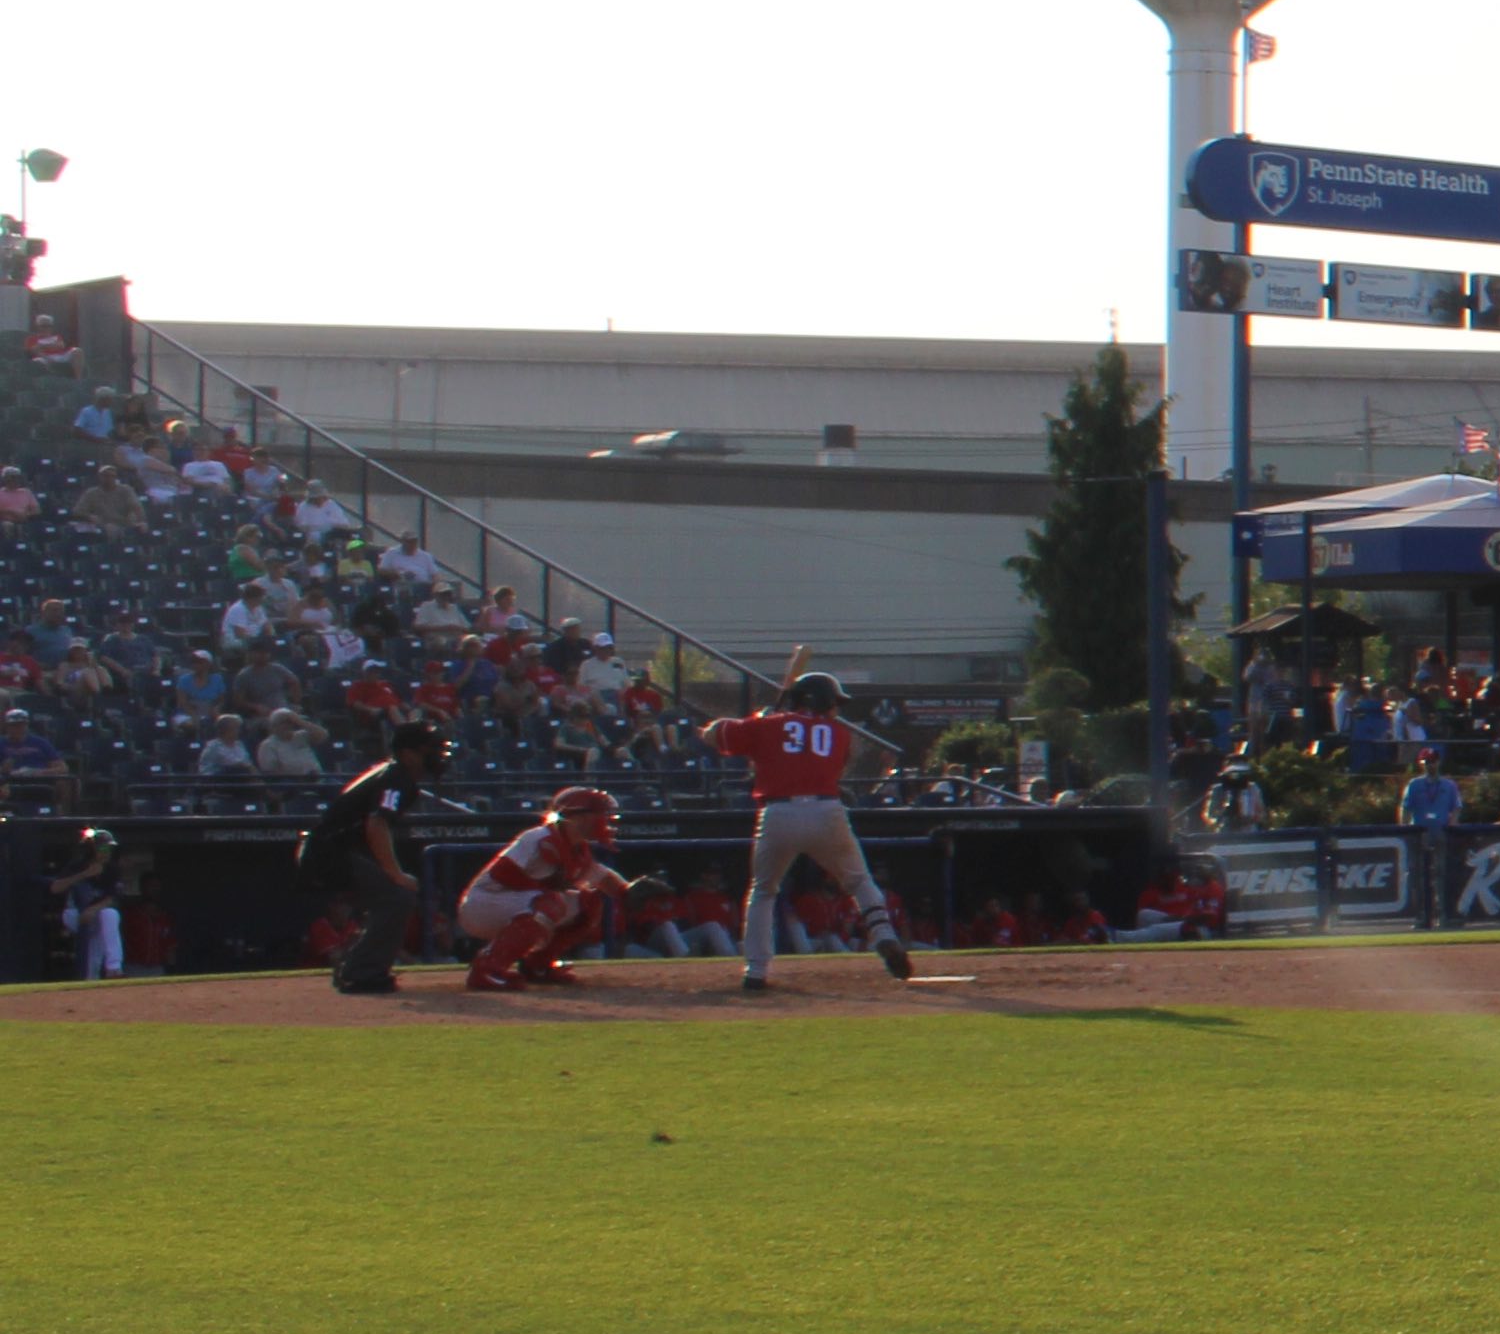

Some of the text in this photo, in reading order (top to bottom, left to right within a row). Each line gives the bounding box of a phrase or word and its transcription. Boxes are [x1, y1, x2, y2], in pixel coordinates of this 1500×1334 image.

[1420, 169, 1490, 195] Health
[1327, 188, 1382, 211] Joseph
[783, 720, 833, 757] 30
